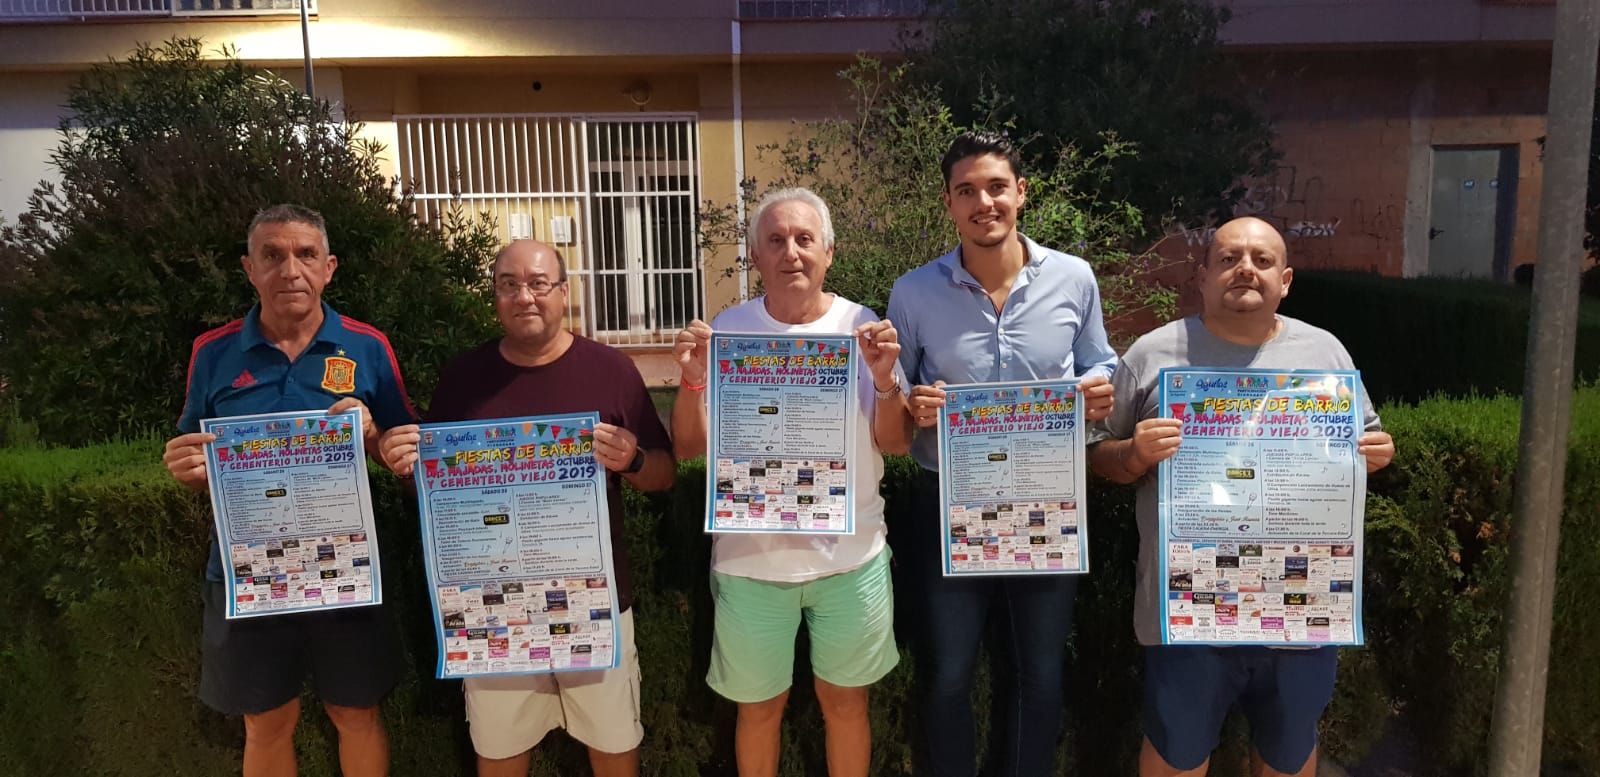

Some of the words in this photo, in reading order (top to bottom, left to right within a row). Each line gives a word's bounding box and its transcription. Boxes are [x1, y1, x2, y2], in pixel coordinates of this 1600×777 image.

[743, 355, 787, 367] FIESTAS
[790, 356, 804, 367] DE
[807, 356, 848, 368] BARRIO
[776, 367, 817, 376] MOLINETAS
[818, 368, 848, 376] OCTUBRE
[720, 375, 726, 384] Y
[729, 376, 786, 384] CEMENTERIO
[790, 376, 817, 385] VIEJO
[818, 376, 848, 386] 2019
[972, 405, 1013, 417] FIESTAS
[1016, 403, 1031, 414] DE
[1034, 402, 1073, 413] BARRIO
[1204, 398, 1261, 413] FIESTAS
[1267, 399, 1288, 412] DE
[1294, 399, 1351, 414] BARRIO
[1003, 414, 1044, 424] MOLINETAS
[1045, 420, 1075, 430] 2019
[1311, 415, 1354, 424] OCTUBRE
[949, 428, 955, 436] Y
[959, 424, 1014, 435] CEMENTERIO
[1017, 423, 1045, 432] VIEJO
[1184, 425, 1264, 437] CEMENTERIO
[1270, 427, 1309, 437] VIEJO
[1313, 425, 1354, 438] 2019
[242, 438, 288, 450] FIESTAS
[291, 435, 307, 446] DE
[310, 432, 351, 445] BARRIO
[279, 446, 322, 457] MOLINETAS
[323, 444, 353, 453] OCTUBRE
[456, 447, 511, 464] FIESTAS
[516, 445, 535, 459] DE
[540, 441, 593, 458] BARRIO
[220, 463, 226, 471] Y
[230, 458, 291, 470] CEMENTERIO
[295, 455, 323, 465] VIEJO
[325, 452, 355, 462] 2019
[556, 455, 596, 466] OCTUBRE
[426, 468, 446, 478] LAS
[500, 459, 555, 473] MOLINETAS
[558, 466, 596, 480] 2019
[427, 480, 434, 489] Y
[440, 473, 516, 488] CEMENTERIO
[521, 470, 556, 482] VIEJO
